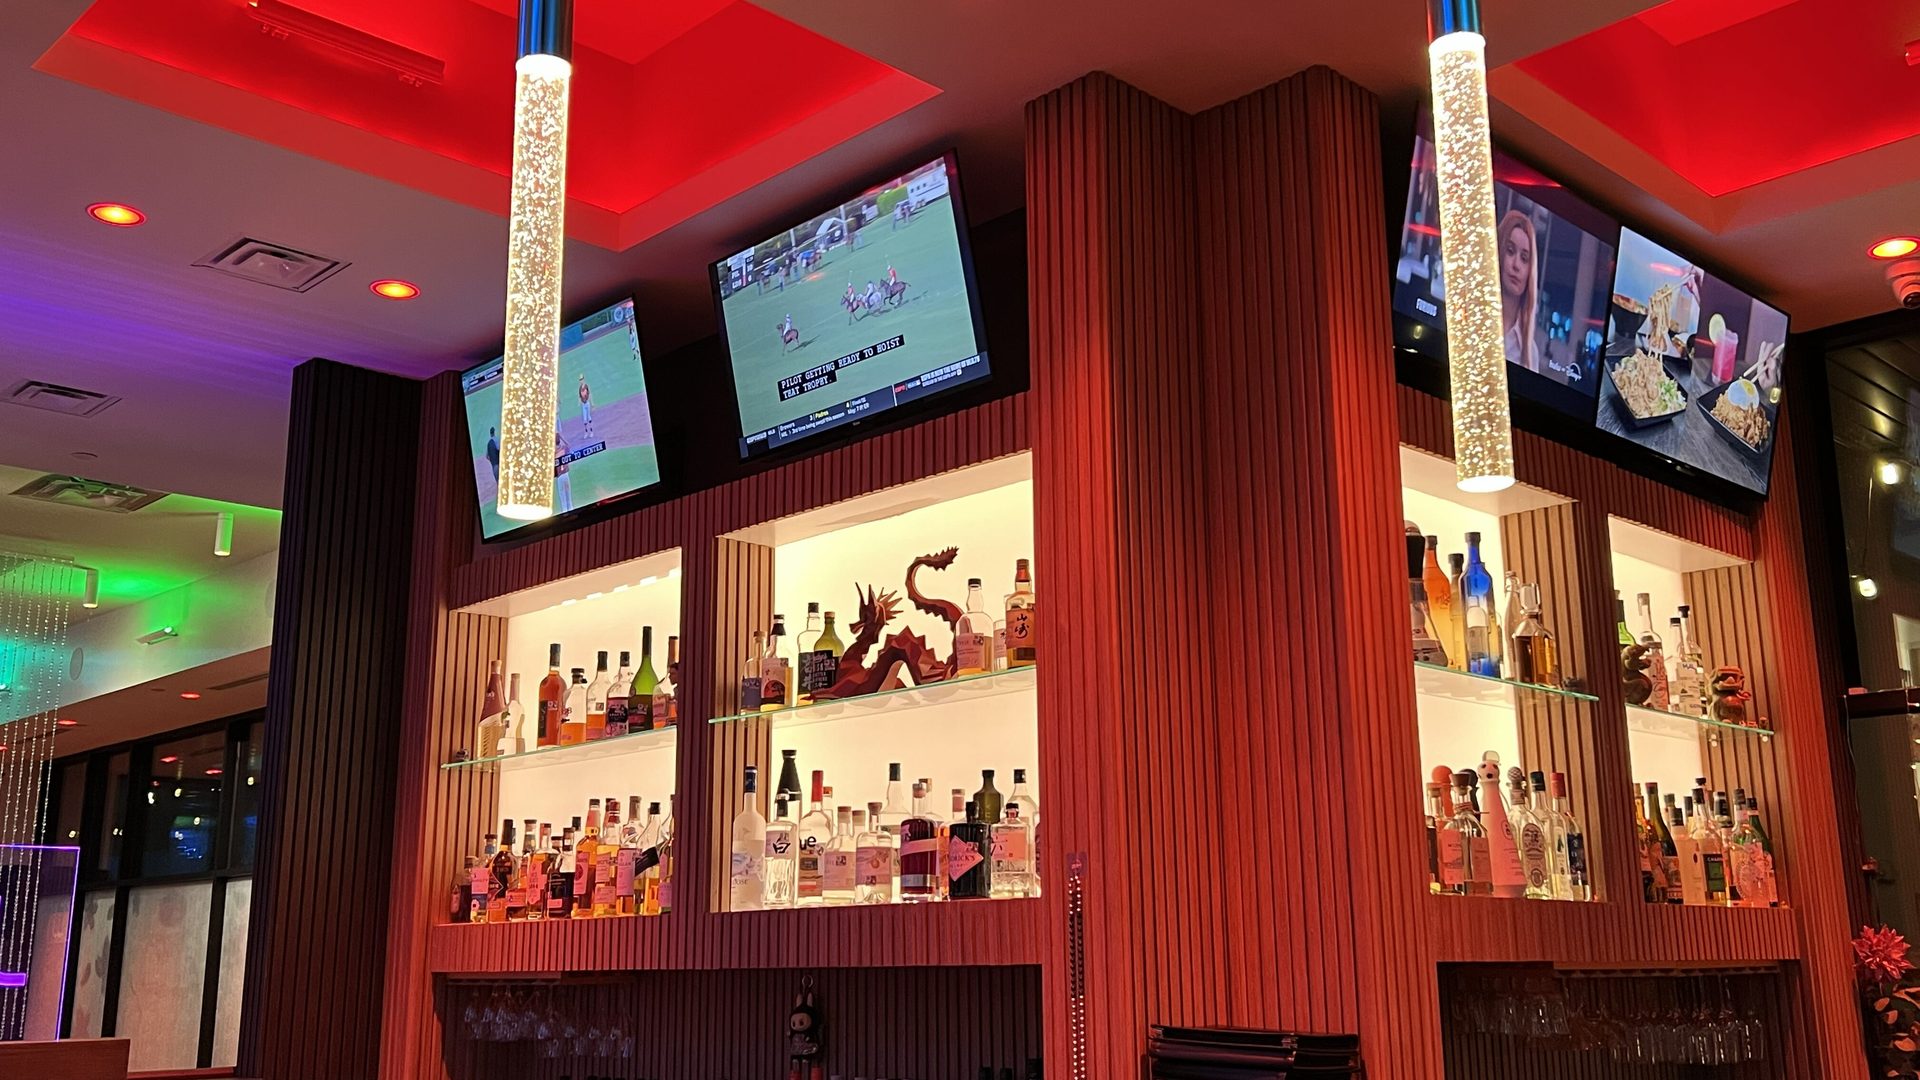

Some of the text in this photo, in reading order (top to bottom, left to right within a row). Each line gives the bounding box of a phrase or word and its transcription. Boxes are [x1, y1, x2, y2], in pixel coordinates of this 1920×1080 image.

[781, 337, 900, 389] PILOT GETTING READY TO HOIST
[783, 375, 832, 399] THAT TROPHY.
[583, 443, 603, 457] CENTER
[799, 836, 816, 850] ue
